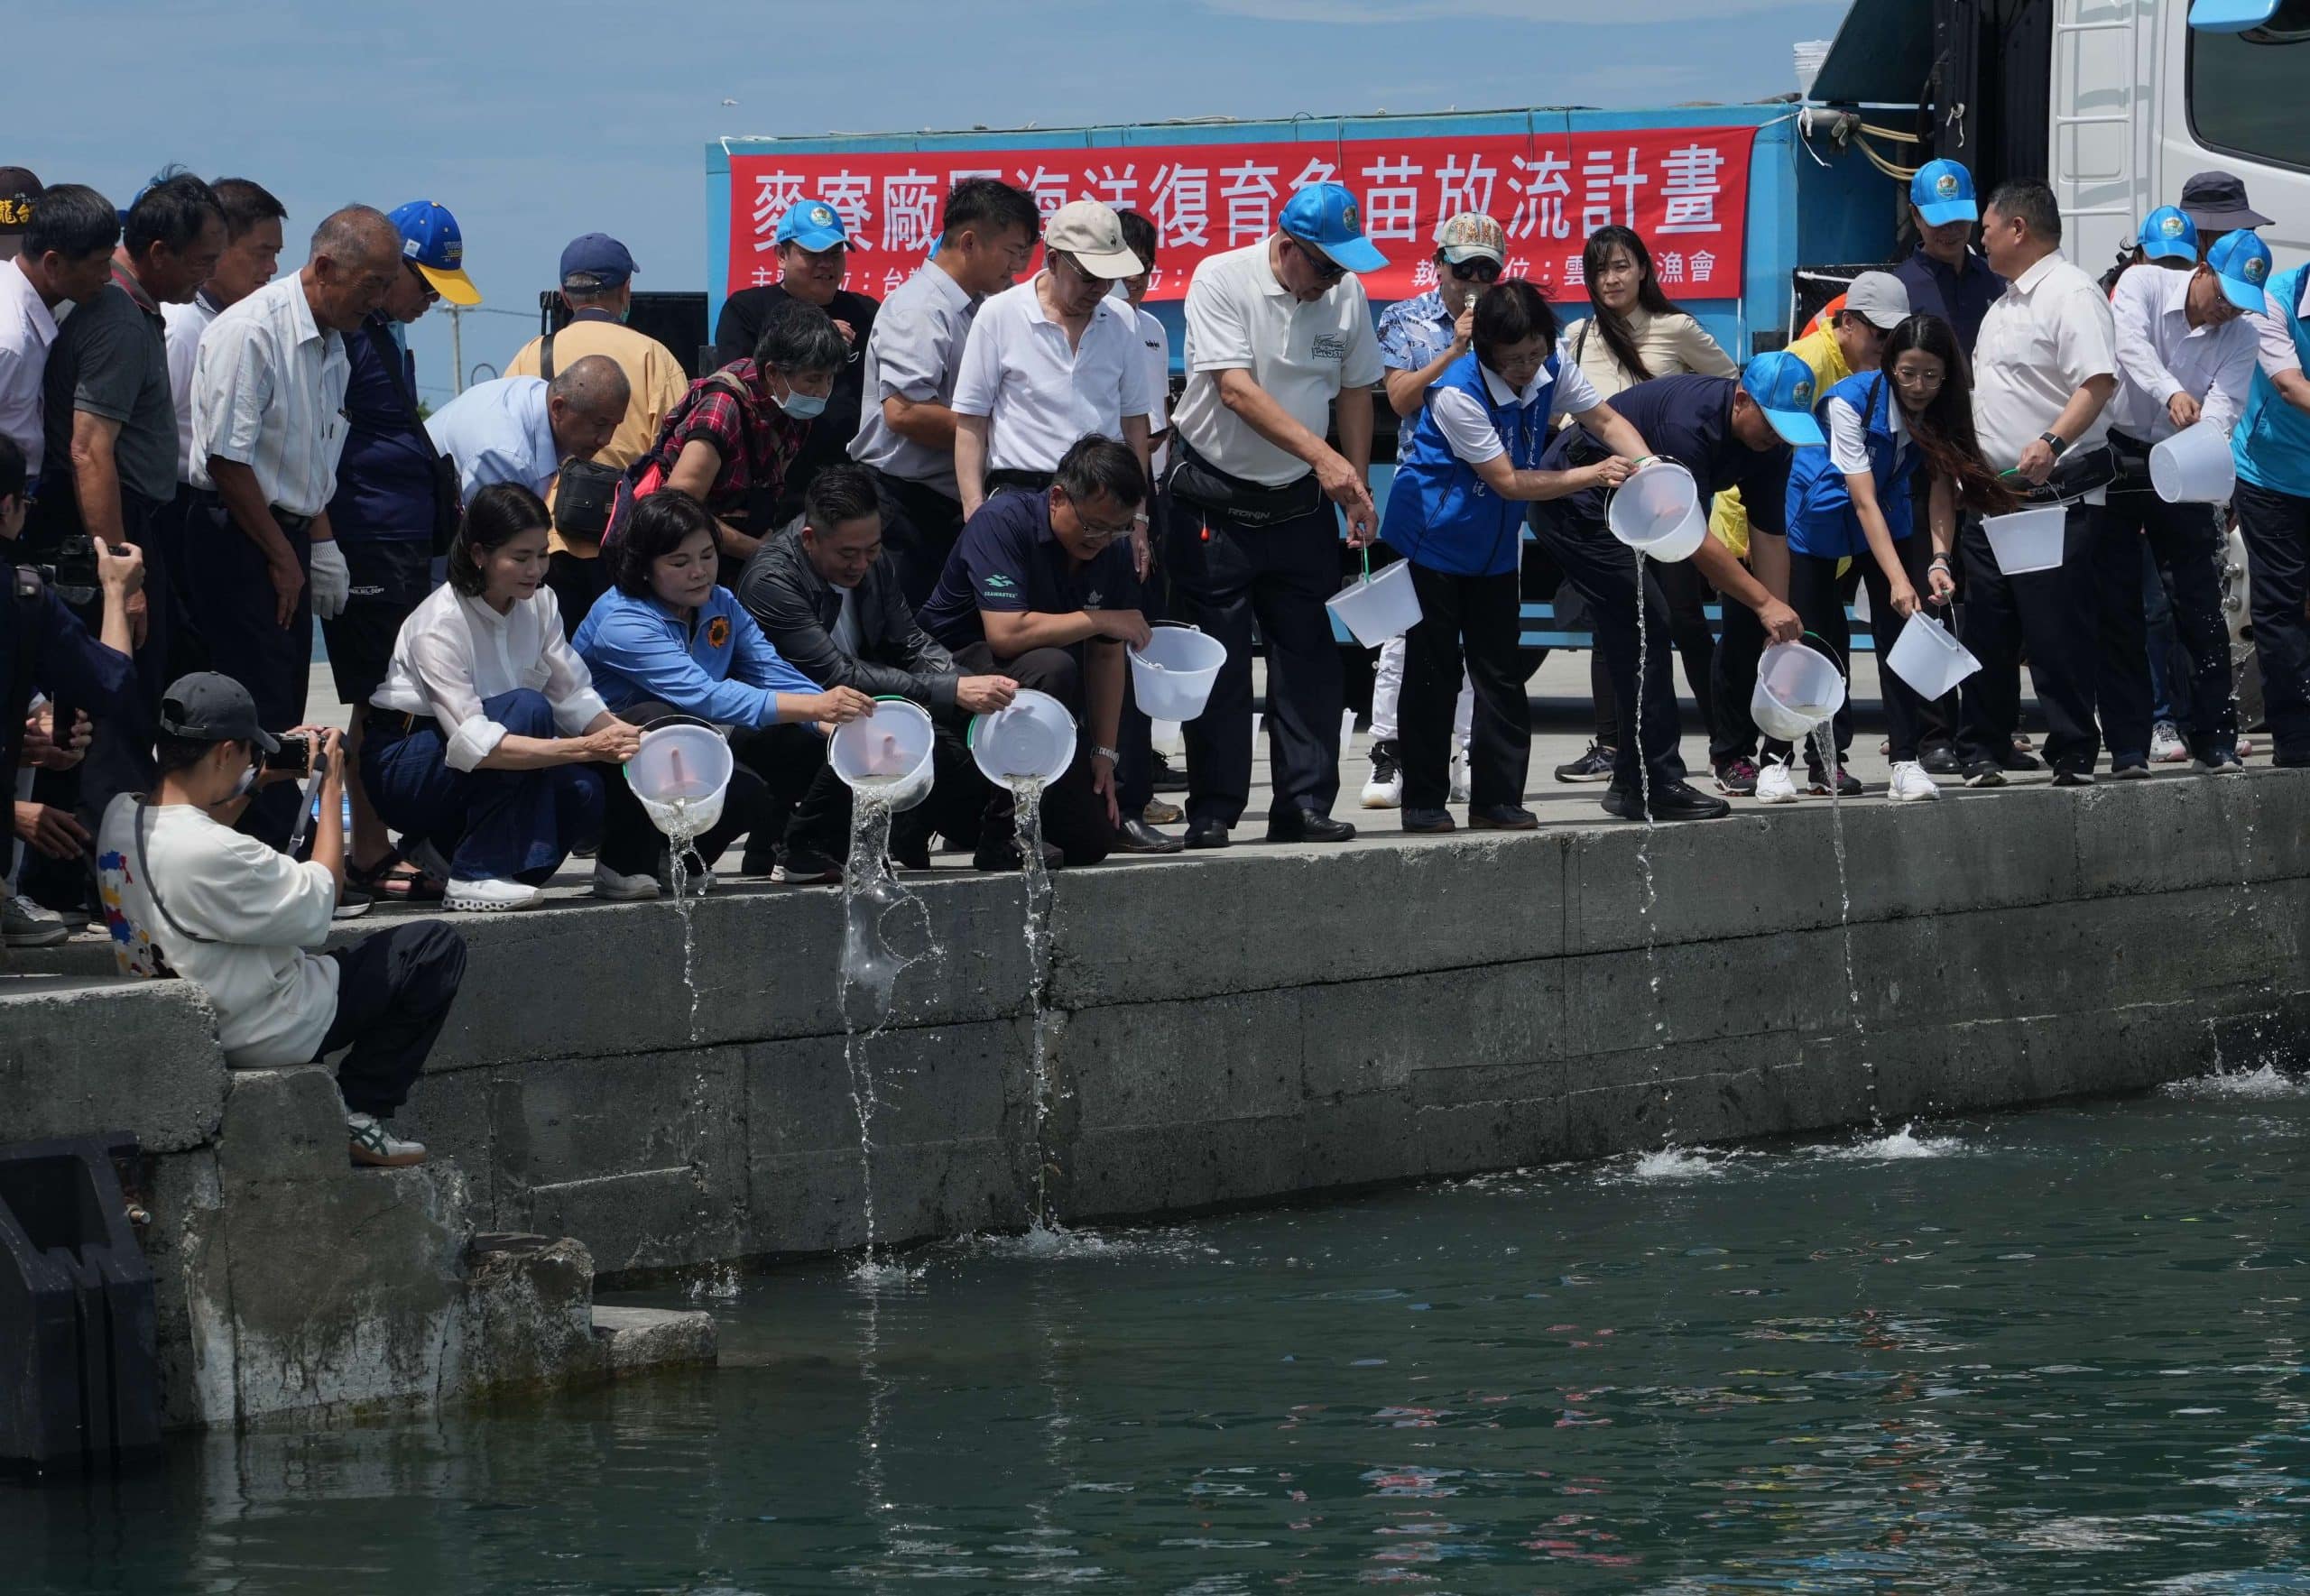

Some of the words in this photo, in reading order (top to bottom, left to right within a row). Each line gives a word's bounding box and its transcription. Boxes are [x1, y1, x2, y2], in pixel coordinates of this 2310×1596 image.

[753, 143, 1725, 254] 麥寮廠海洋復育苗放流計畫
[1228, 507, 1270, 521] RONIN
